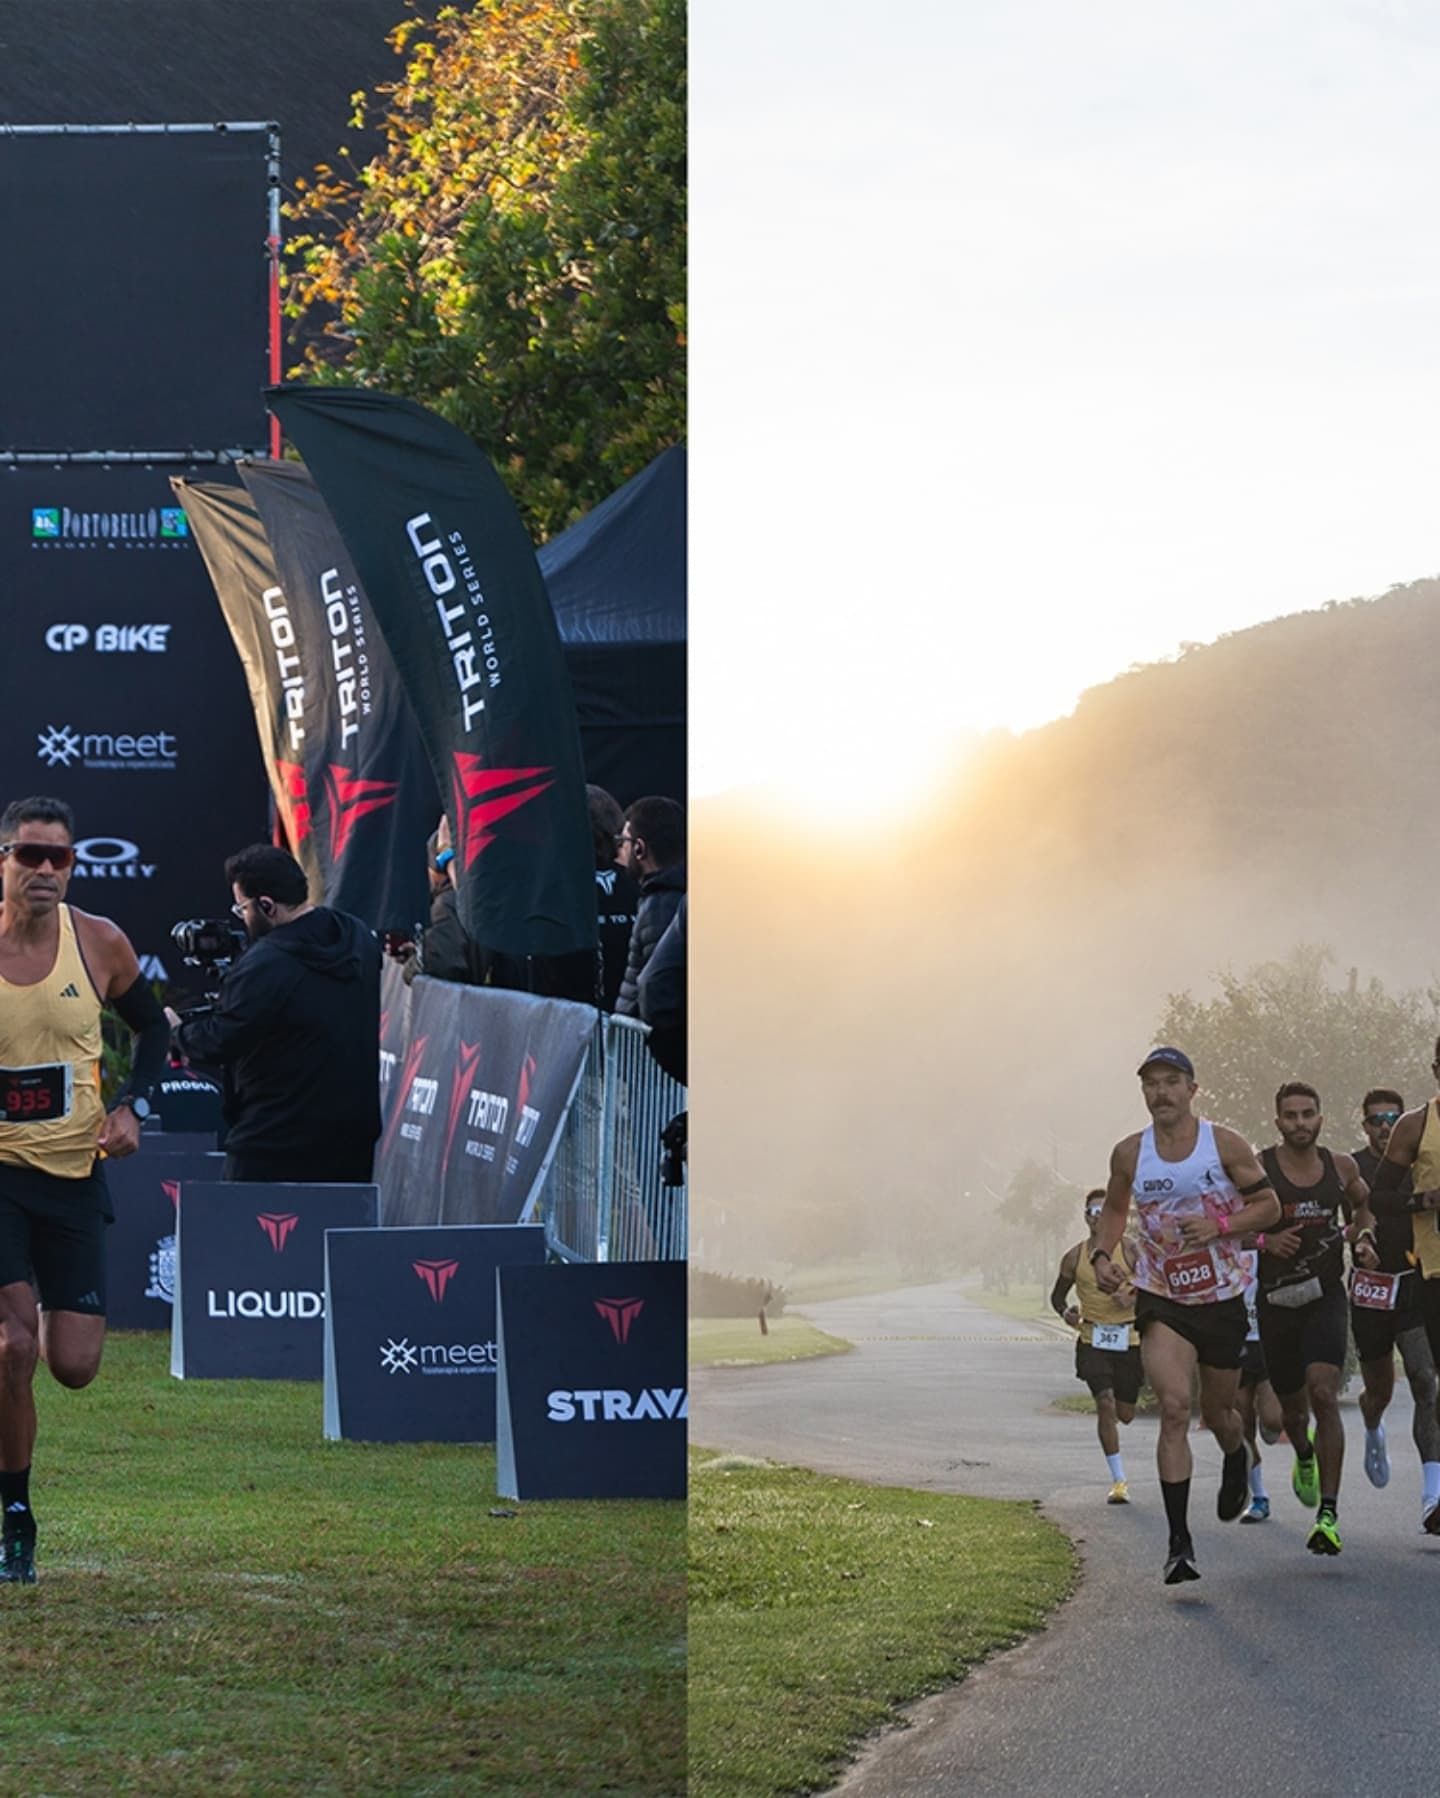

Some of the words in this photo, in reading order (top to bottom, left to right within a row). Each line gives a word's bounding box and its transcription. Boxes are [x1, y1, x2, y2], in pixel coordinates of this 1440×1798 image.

[63, 507, 158, 538] PORTOBELLO
[448, 531, 485, 607] SERIES
[346, 585, 367, 648] SERIES
[406, 512, 486, 733] TRITON
[45, 624, 89, 652] CP
[95, 624, 171, 652] BIKE
[476, 613, 501, 688] WORLD
[262, 586, 305, 751] TRITON
[320, 568, 360, 750] TRITON
[357, 653, 372, 715] WORLD
[83, 731, 178, 757] meet
[73, 864, 157, 877] AKLEY
[6, 1088, 52, 1112] 935
[1168, 1264, 1212, 1288] 6028
[1354, 1283, 1389, 1300] 6023
[420, 1340, 498, 1364] meet
